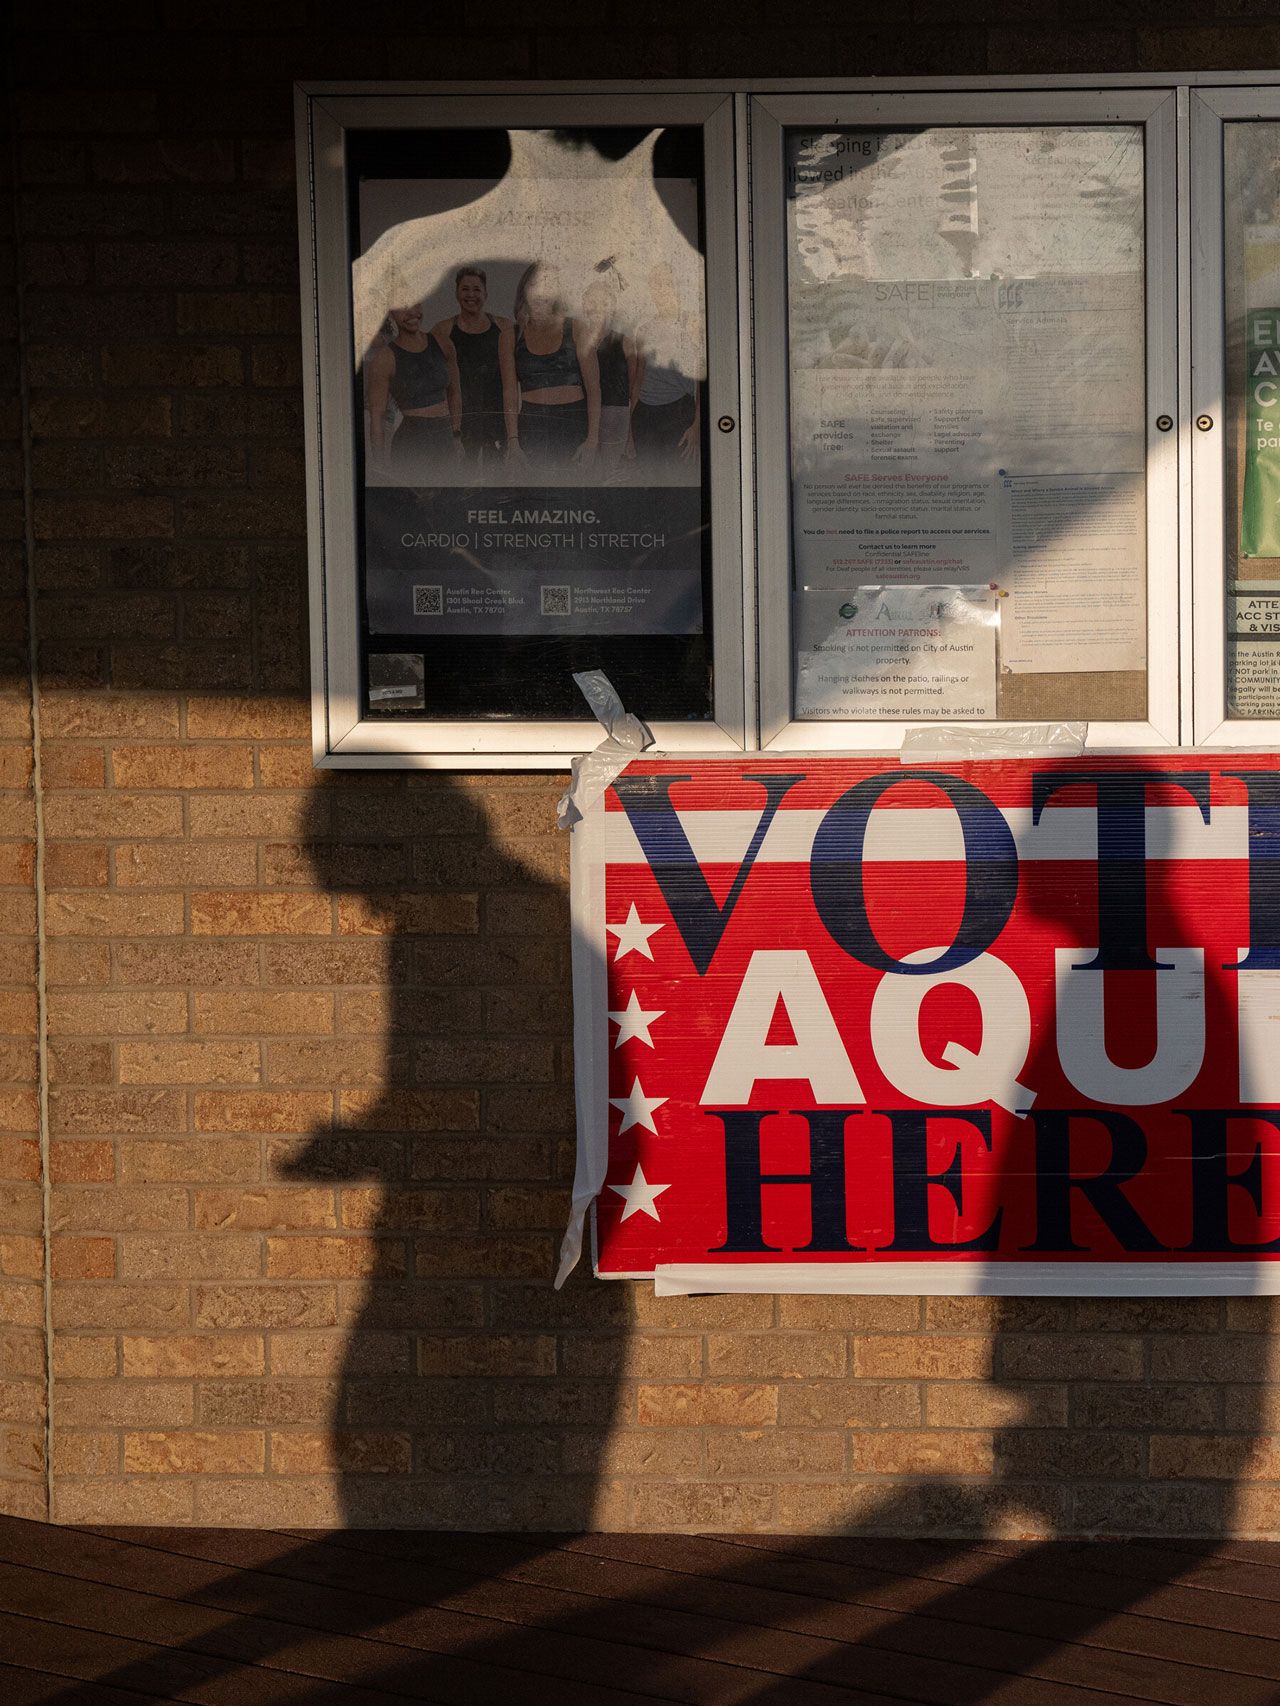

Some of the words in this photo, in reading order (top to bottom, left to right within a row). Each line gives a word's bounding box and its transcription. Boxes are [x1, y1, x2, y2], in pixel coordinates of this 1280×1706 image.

[788, 166, 843, 183] llowed
[1256, 419, 1273, 432] Te
[844, 474, 869, 482] SAFE
[872, 474, 902, 482] Serves
[905, 474, 949, 483] Everyone
[467, 510, 509, 524] FEEL
[511, 510, 601, 524] AMAZING.
[401, 533, 470, 549] CARDIO
[483, 533, 574, 549] STRENGTH
[588, 533, 666, 549] STRETCH
[1236, 612, 1262, 620] ACC
[1249, 623, 1258, 632] &
[846, 628, 896, 637] ATTENTION
[897, 628, 941, 637] PATRONS:
[813, 644, 846, 653] Smoking
[871, 644, 909, 653] permitted
[923, 644, 938, 653] City
[875, 656, 911, 666] property.
[1252, 668, 1268, 676] park
[818, 675, 850, 684] Hanging
[931, 675, 959, 684] railings
[842, 687, 880, 696] walkways
[904, 687, 945, 696] permitted.
[802, 706, 830, 714] Visitors
[831, 706, 847, 714] who
[848, 706, 877, 714] violate
[878, 706, 900, 714] these
[902, 706, 921, 714] rules
[941, 706, 951, 714] be
[953, 706, 975, 714] asked
[976, 706, 985, 714] to
